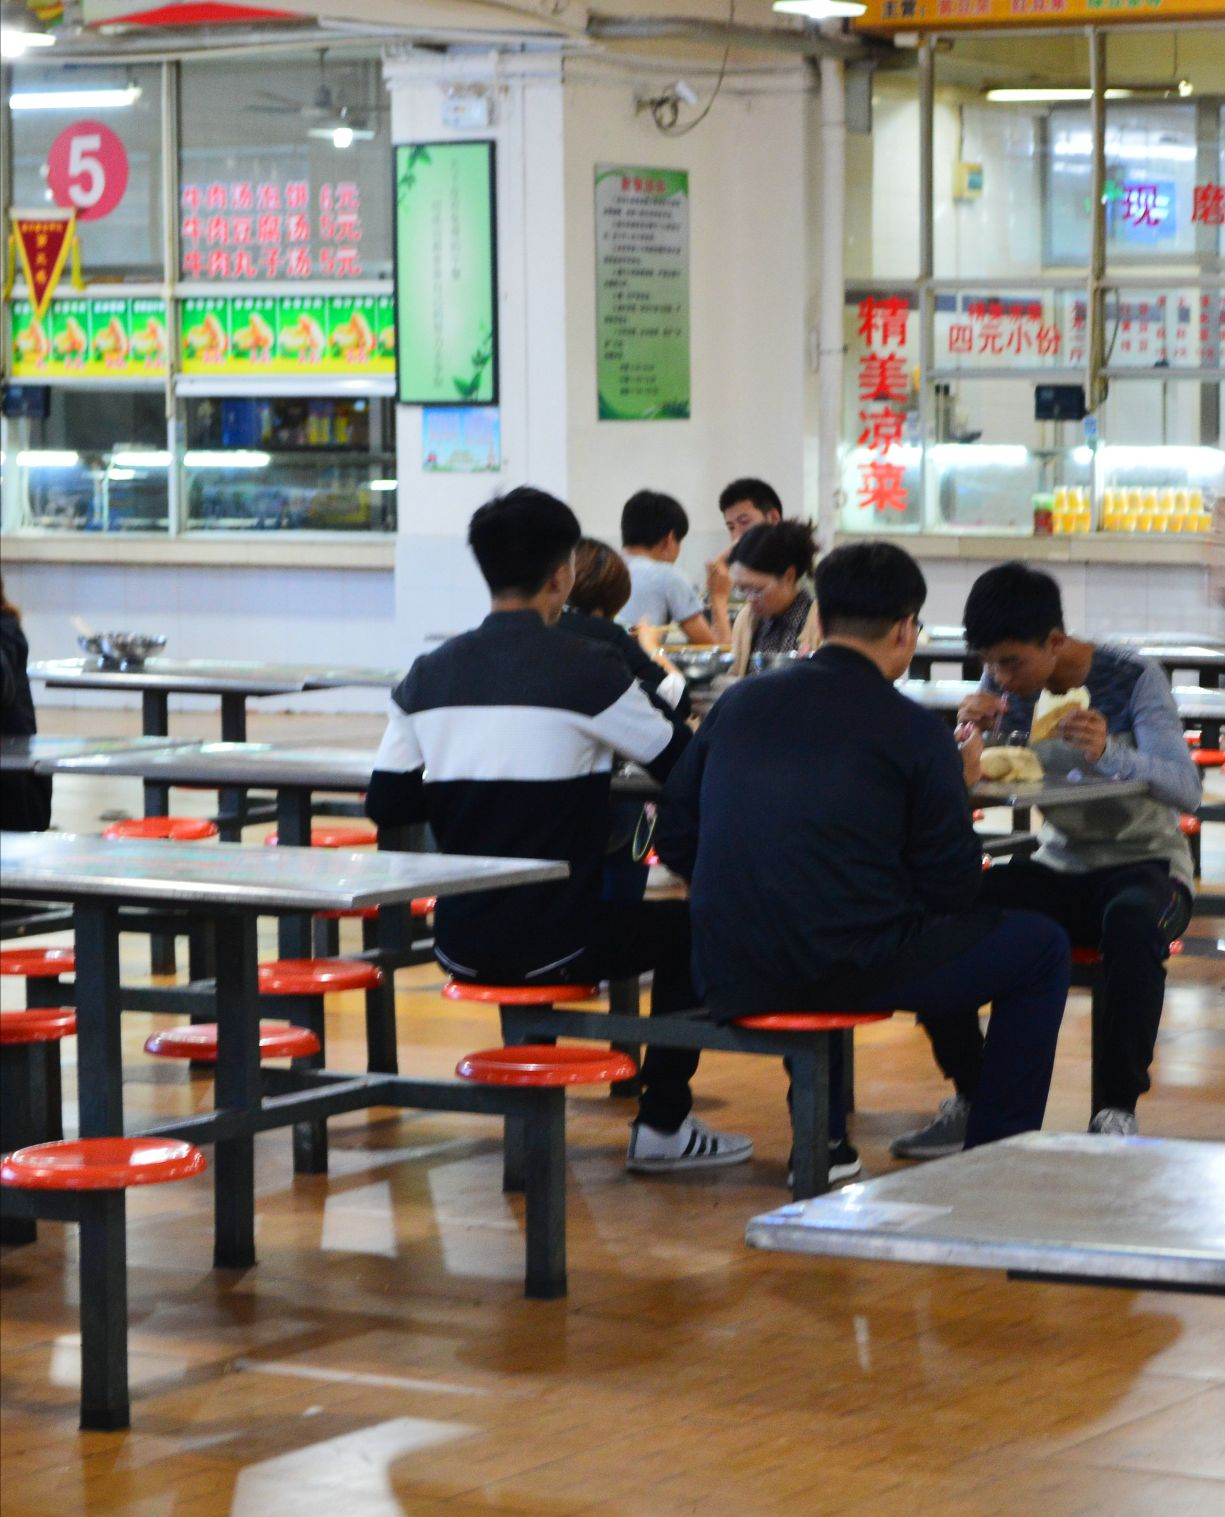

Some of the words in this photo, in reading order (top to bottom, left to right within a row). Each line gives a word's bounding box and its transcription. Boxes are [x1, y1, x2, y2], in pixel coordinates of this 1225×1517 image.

[69, 134, 106, 207] 5
[319, 211, 363, 242] 5元
[182, 246, 313, 280] 牛肉丸子汤
[319, 245, 363, 279] 5元
[948, 323, 1062, 357] 四元小份
[857, 295, 909, 513] 精美凉菜
